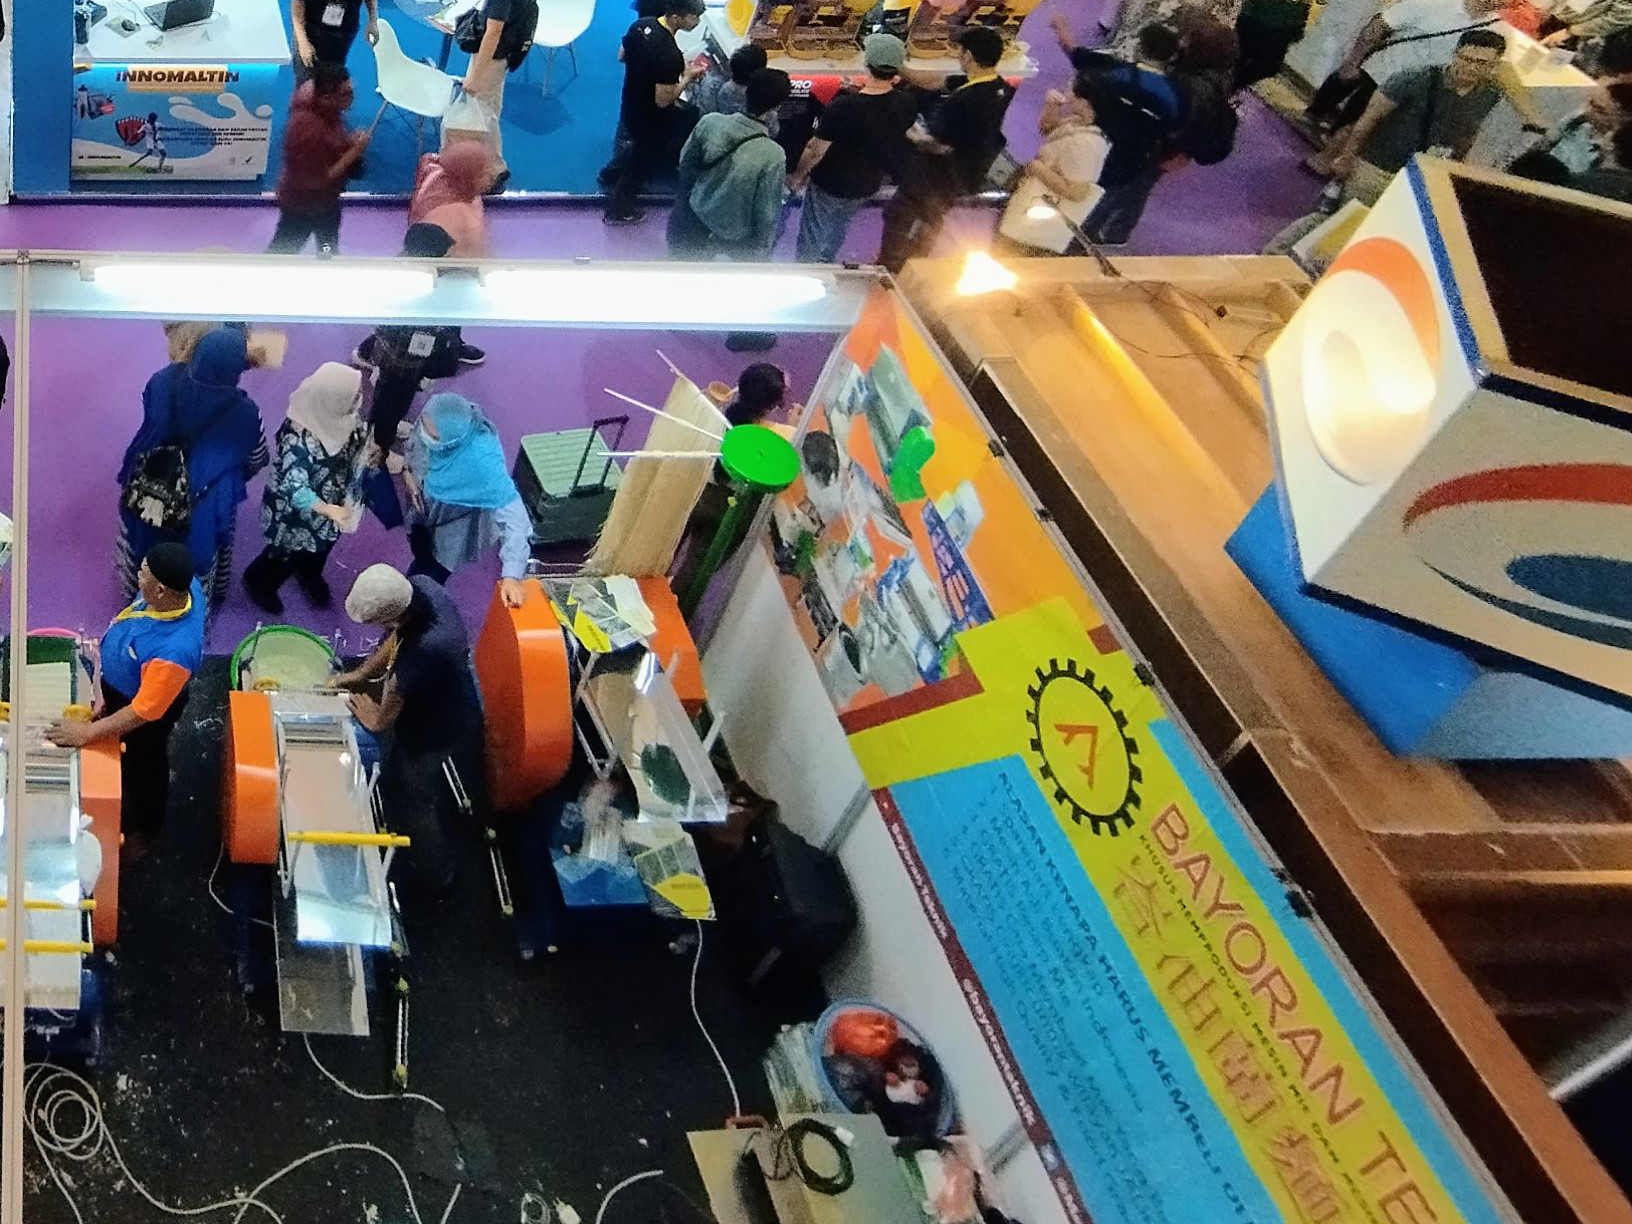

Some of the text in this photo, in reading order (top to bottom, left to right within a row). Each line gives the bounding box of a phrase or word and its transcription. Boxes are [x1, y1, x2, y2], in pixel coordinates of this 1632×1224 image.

[116, 70, 240, 83] INNOMALTIN
[1045, 857, 1097, 951] KENAPA
[1098, 954, 1151, 1043] HARUS
[1147, 1047, 1223, 1175] MEMBELI
[1150, 802, 1366, 1126] BAYORAN
[1177, 897, 1253, 1019] MEMPRODUKSI
[1252, 1021, 1288, 1079] MESIN
